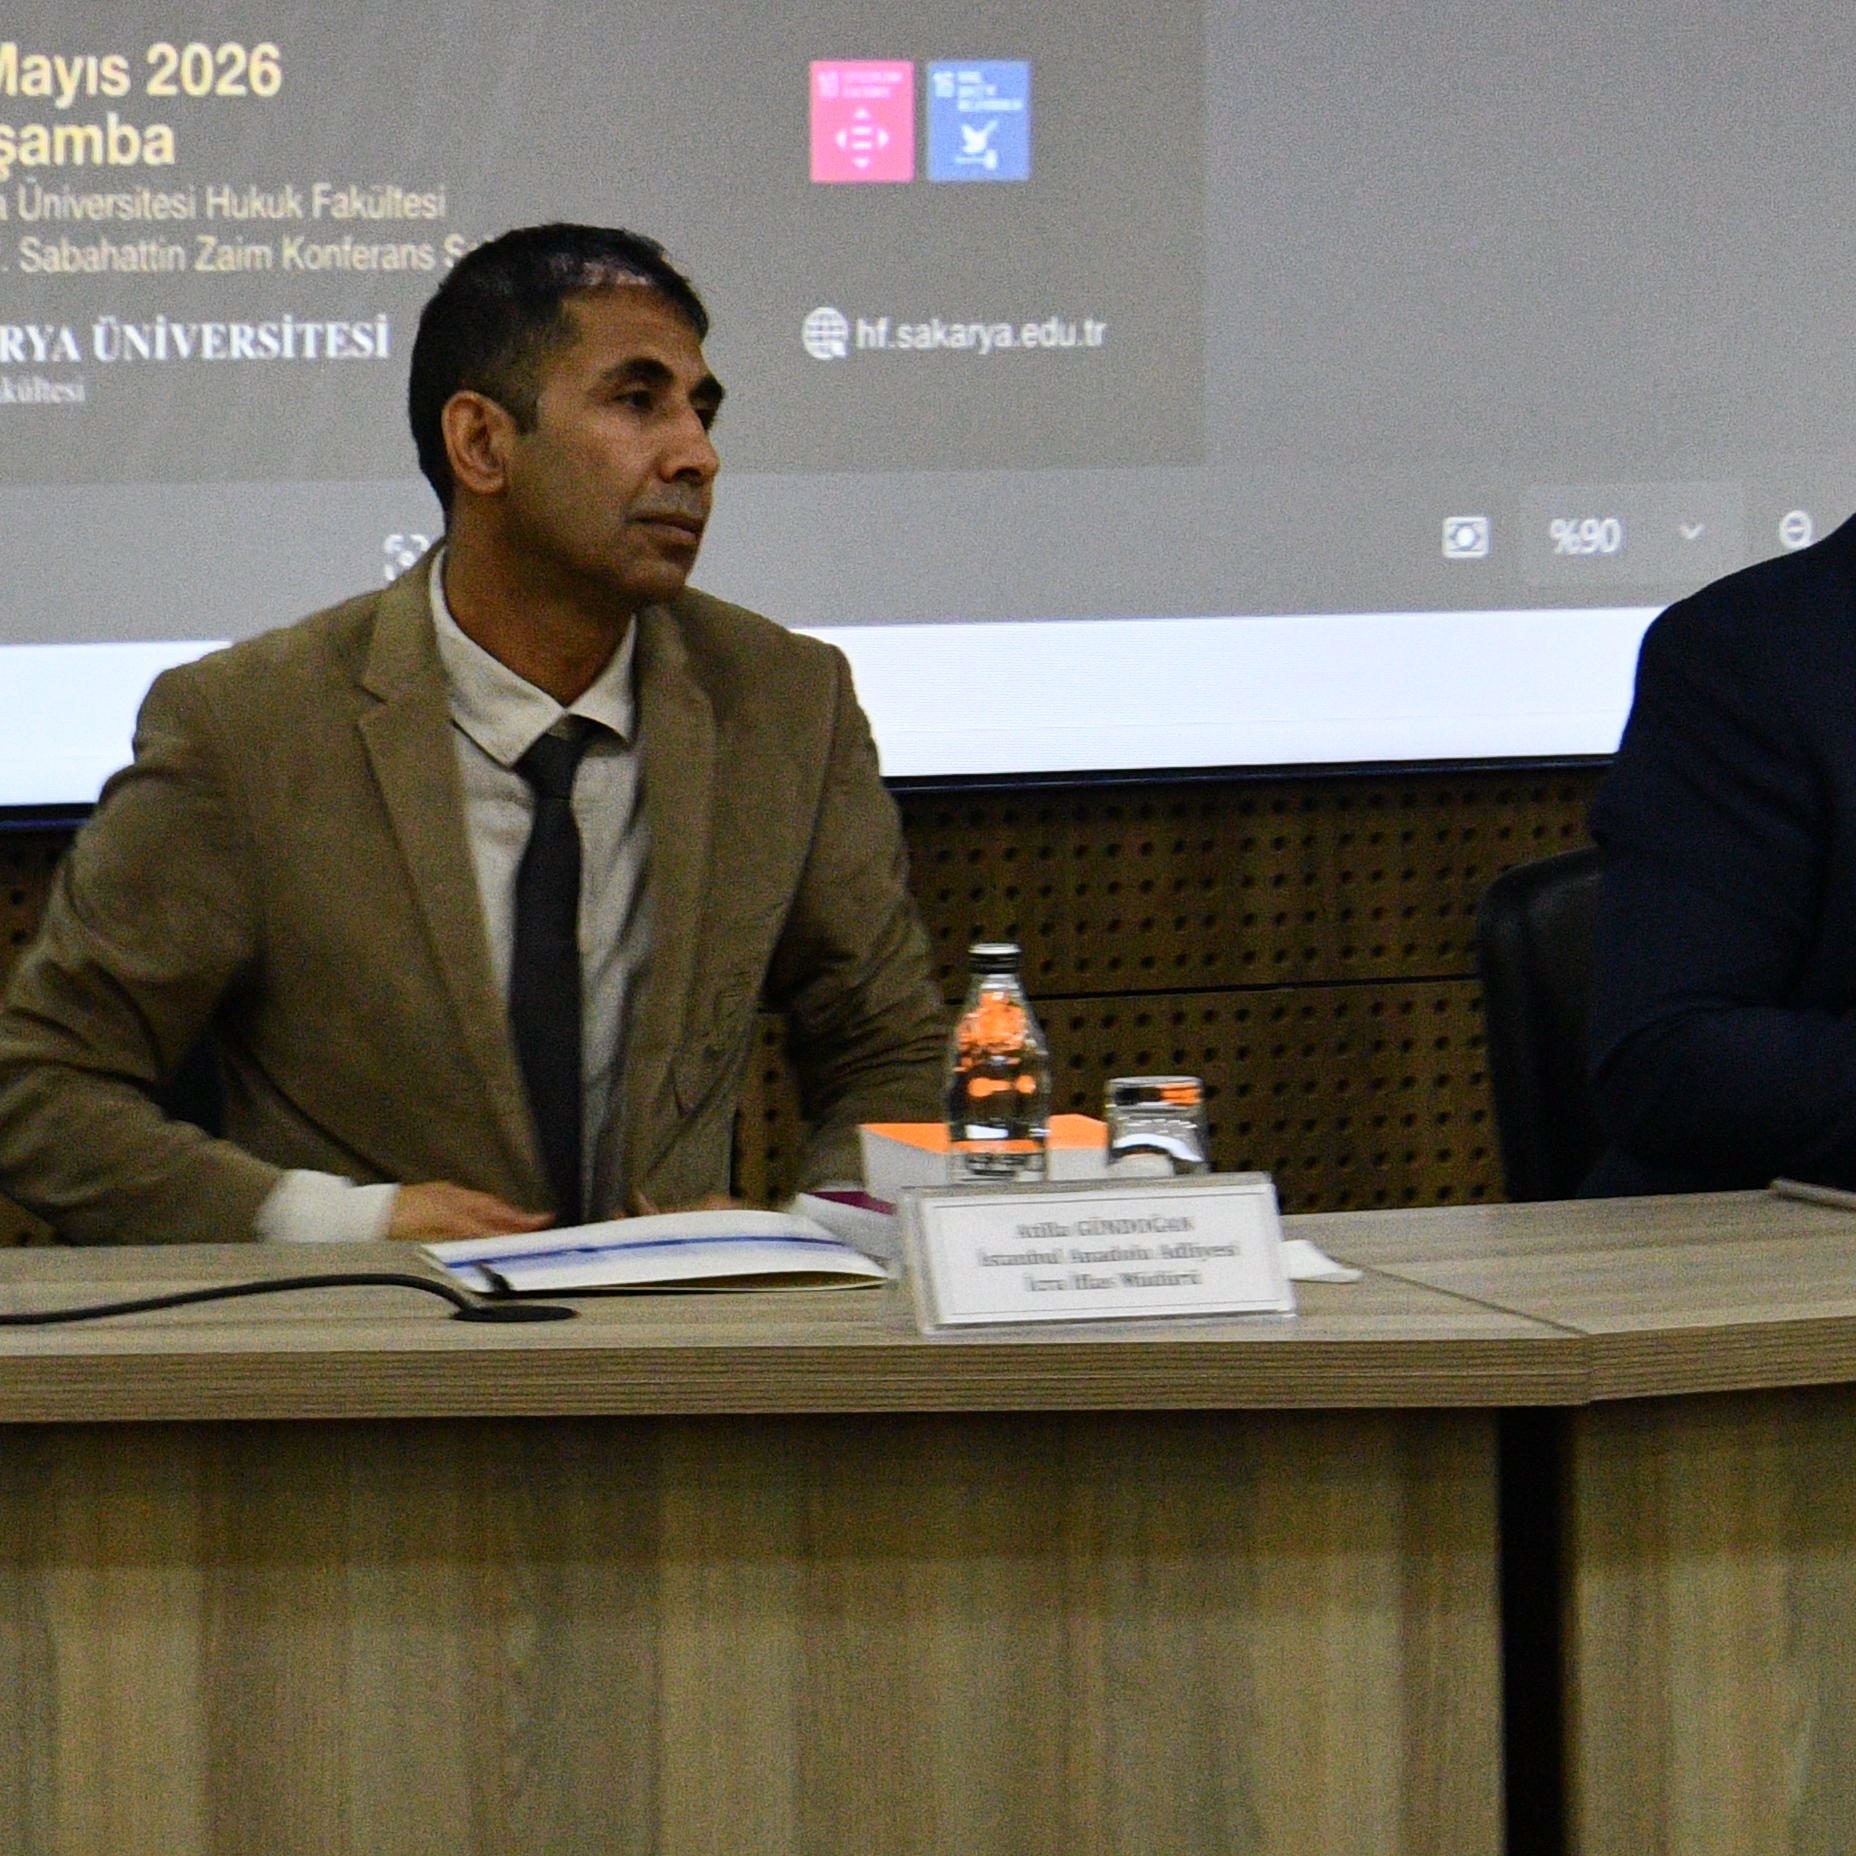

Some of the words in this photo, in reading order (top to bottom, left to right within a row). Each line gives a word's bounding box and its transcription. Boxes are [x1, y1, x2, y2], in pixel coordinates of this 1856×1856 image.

[145, 39, 283, 97] 2026
[18, 177, 197, 221] Üniversitesi
[204, 185, 304, 220] Hukuk
[309, 184, 448, 219] Fakültesi
[18, 237, 186, 273] Sabahattin
[195, 236, 273, 271] Zaim
[280, 235, 437, 270] Konferans
[91, 308, 393, 362] ÜNİVERSİTESİ
[856, 316, 1106, 355] hf.sakarya.edu.tr
[1549, 517, 1622, 555] %90
